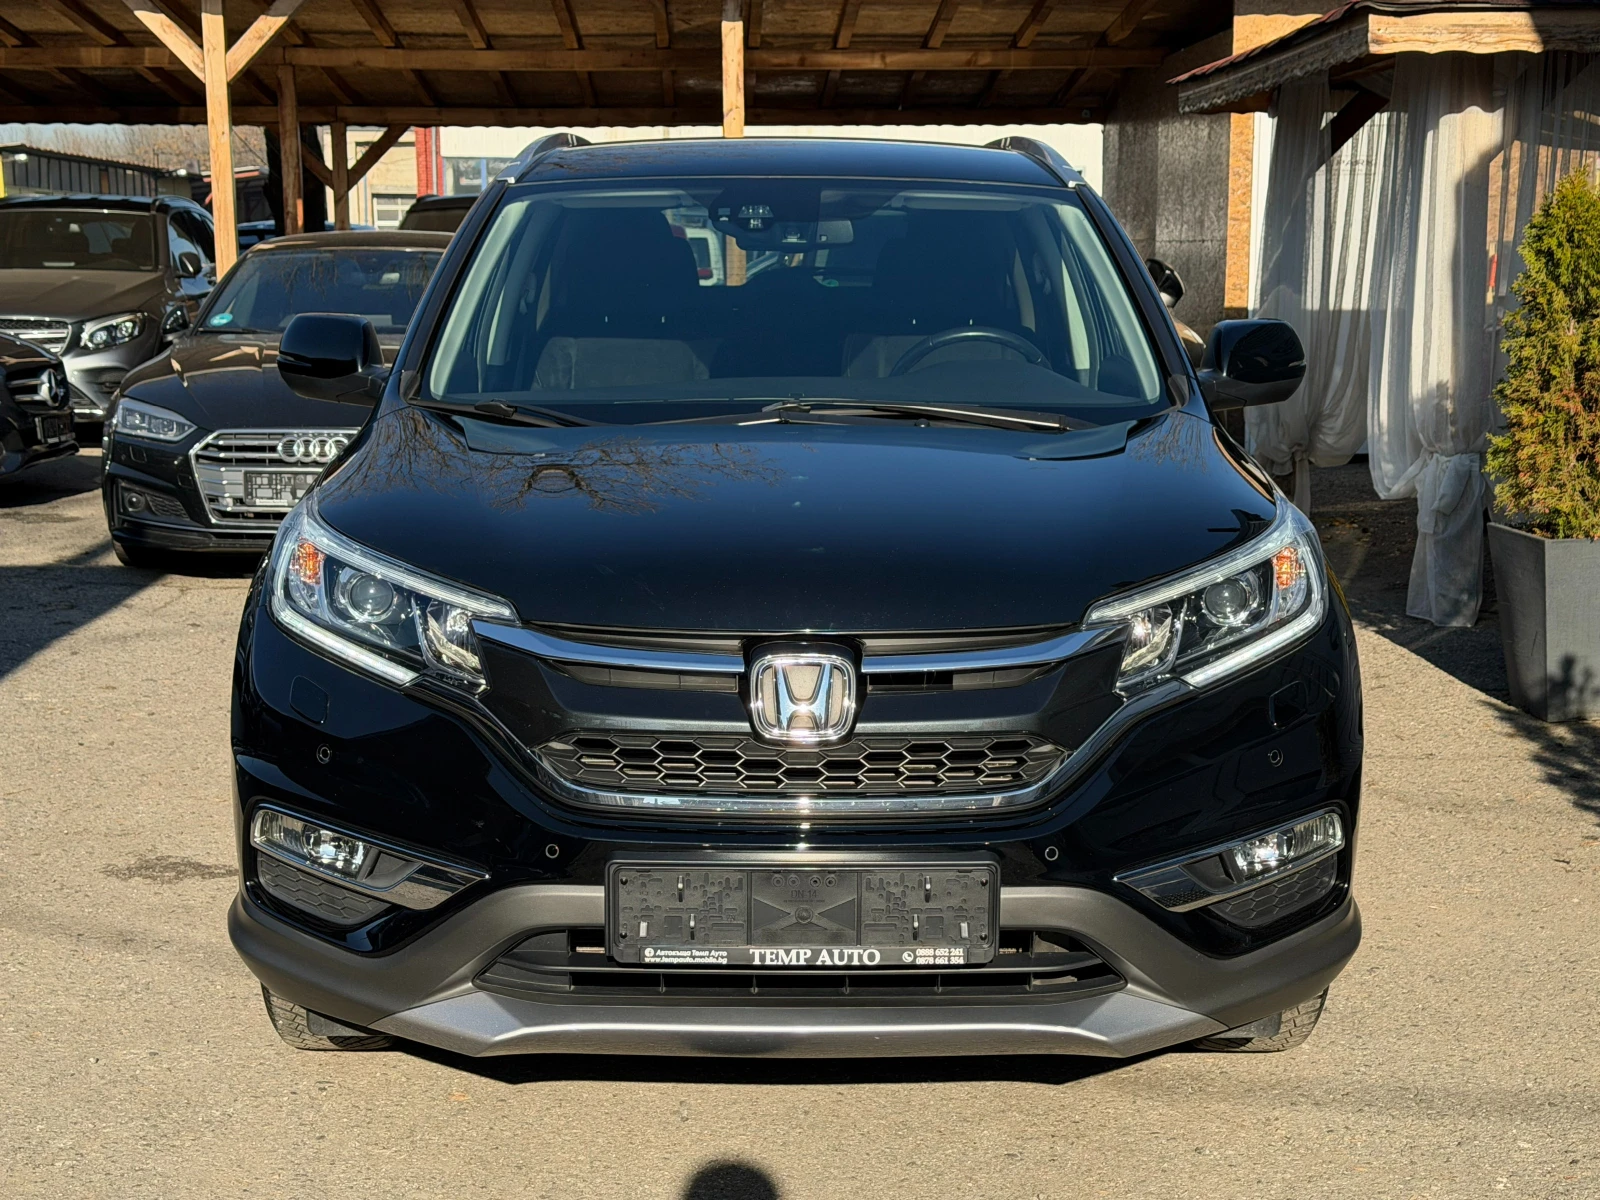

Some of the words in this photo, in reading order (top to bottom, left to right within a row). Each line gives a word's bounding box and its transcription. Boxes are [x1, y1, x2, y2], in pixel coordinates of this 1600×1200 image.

[935, 948, 949, 956] 652
[749, 949, 812, 965] TEMP
[816, 949, 881, 965] AUTO
[935, 957, 949, 965] 661
